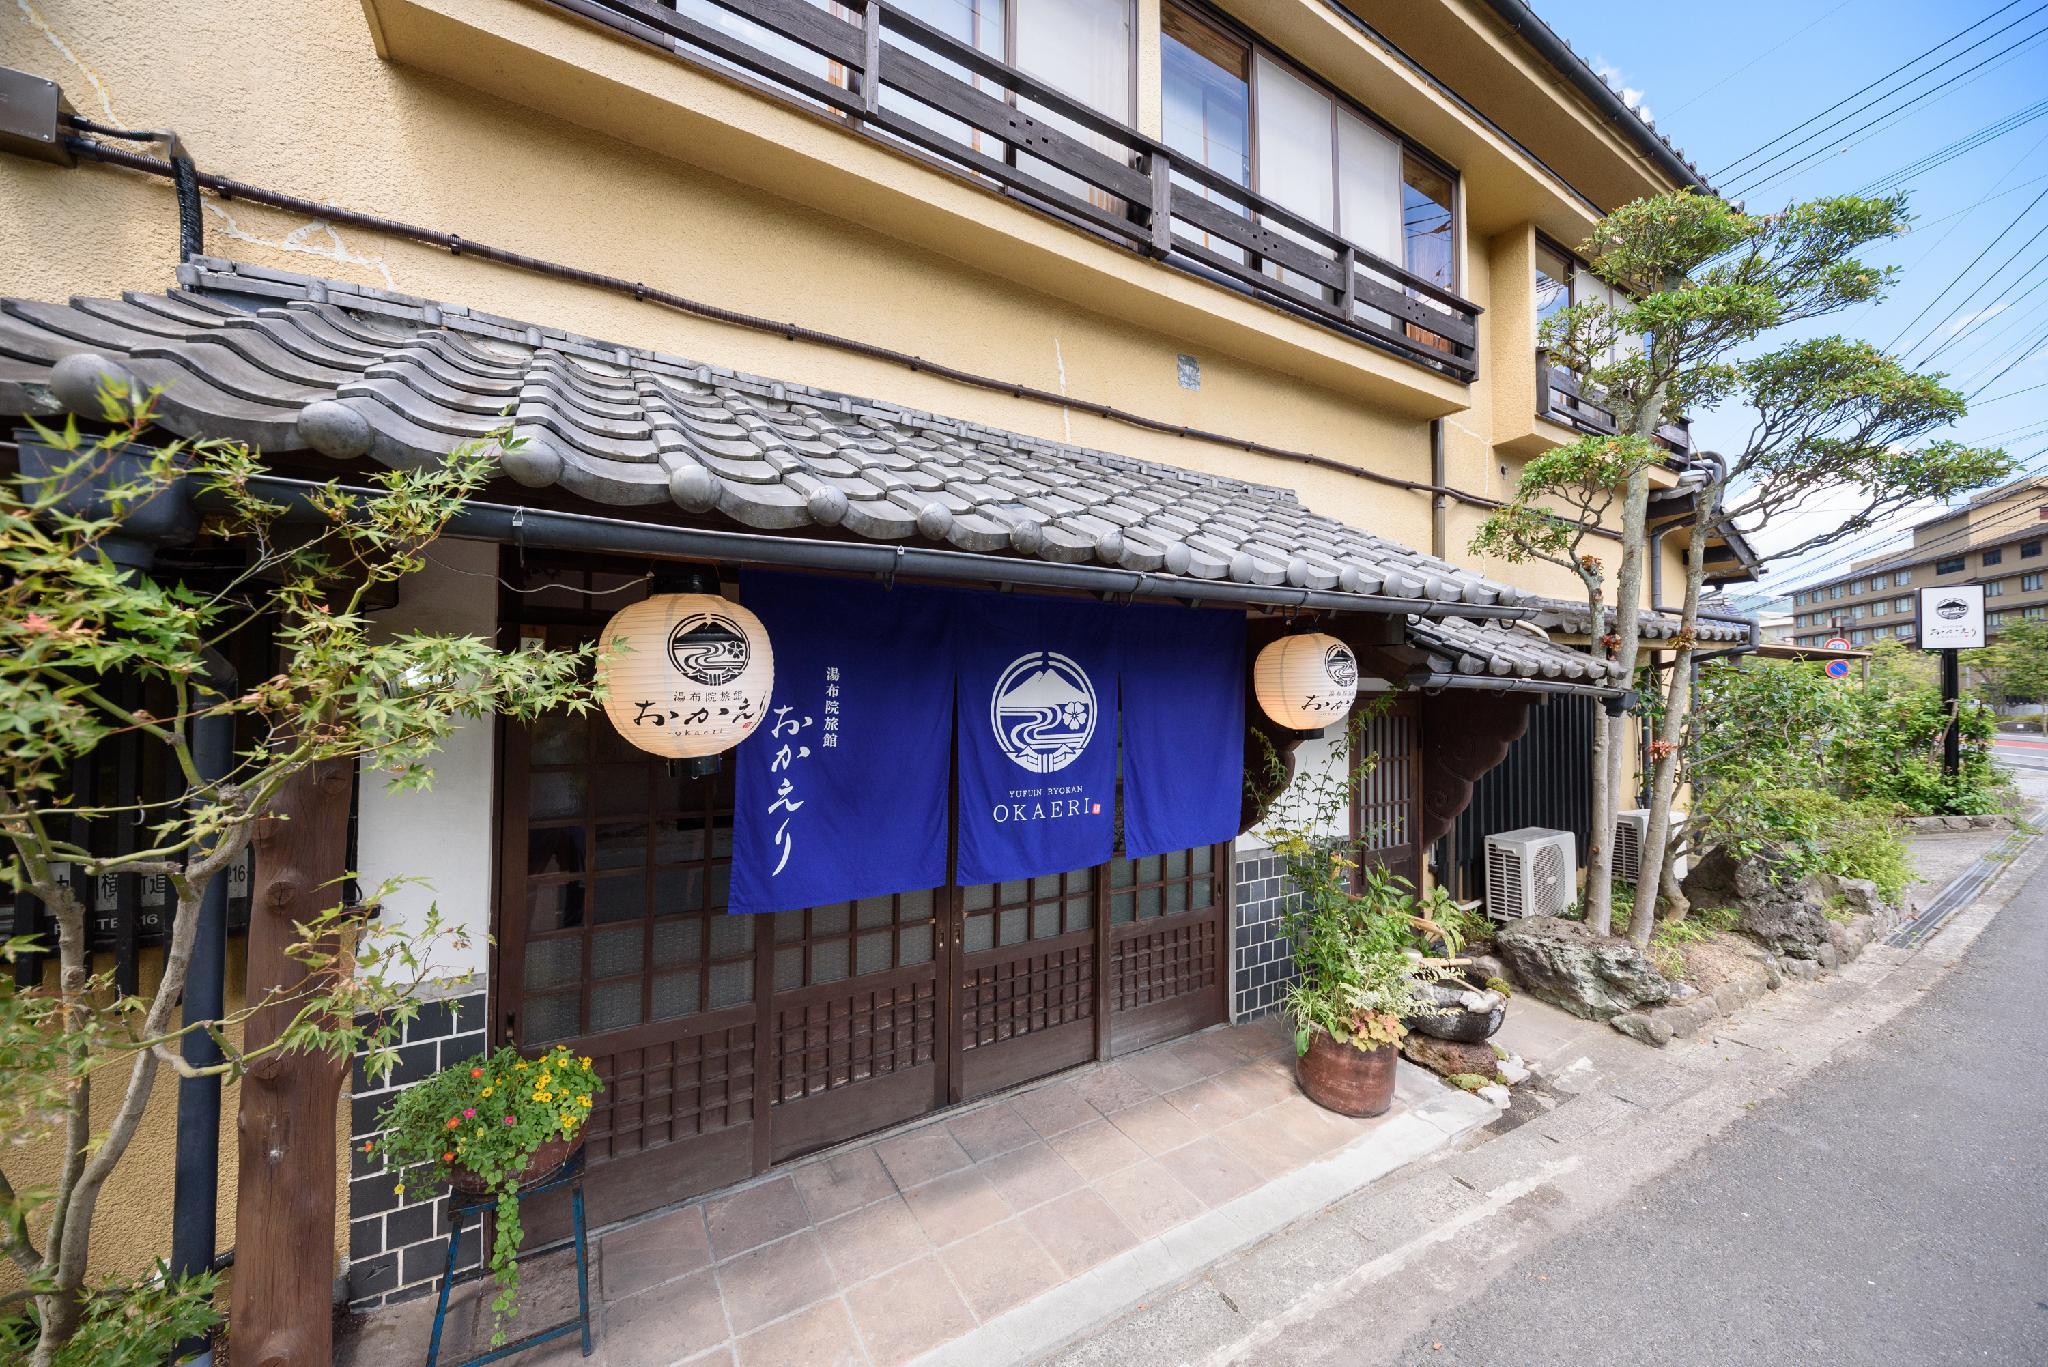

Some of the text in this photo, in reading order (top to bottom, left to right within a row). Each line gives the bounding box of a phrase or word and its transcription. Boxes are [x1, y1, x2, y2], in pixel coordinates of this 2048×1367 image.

[822, 666, 840, 748] 湯布院旅館
[768, 704, 814, 877] おかえり
[993, 798, 1091, 823] OKAERI
[1009, 785, 1083, 798] YUFUIN RYOKAN
